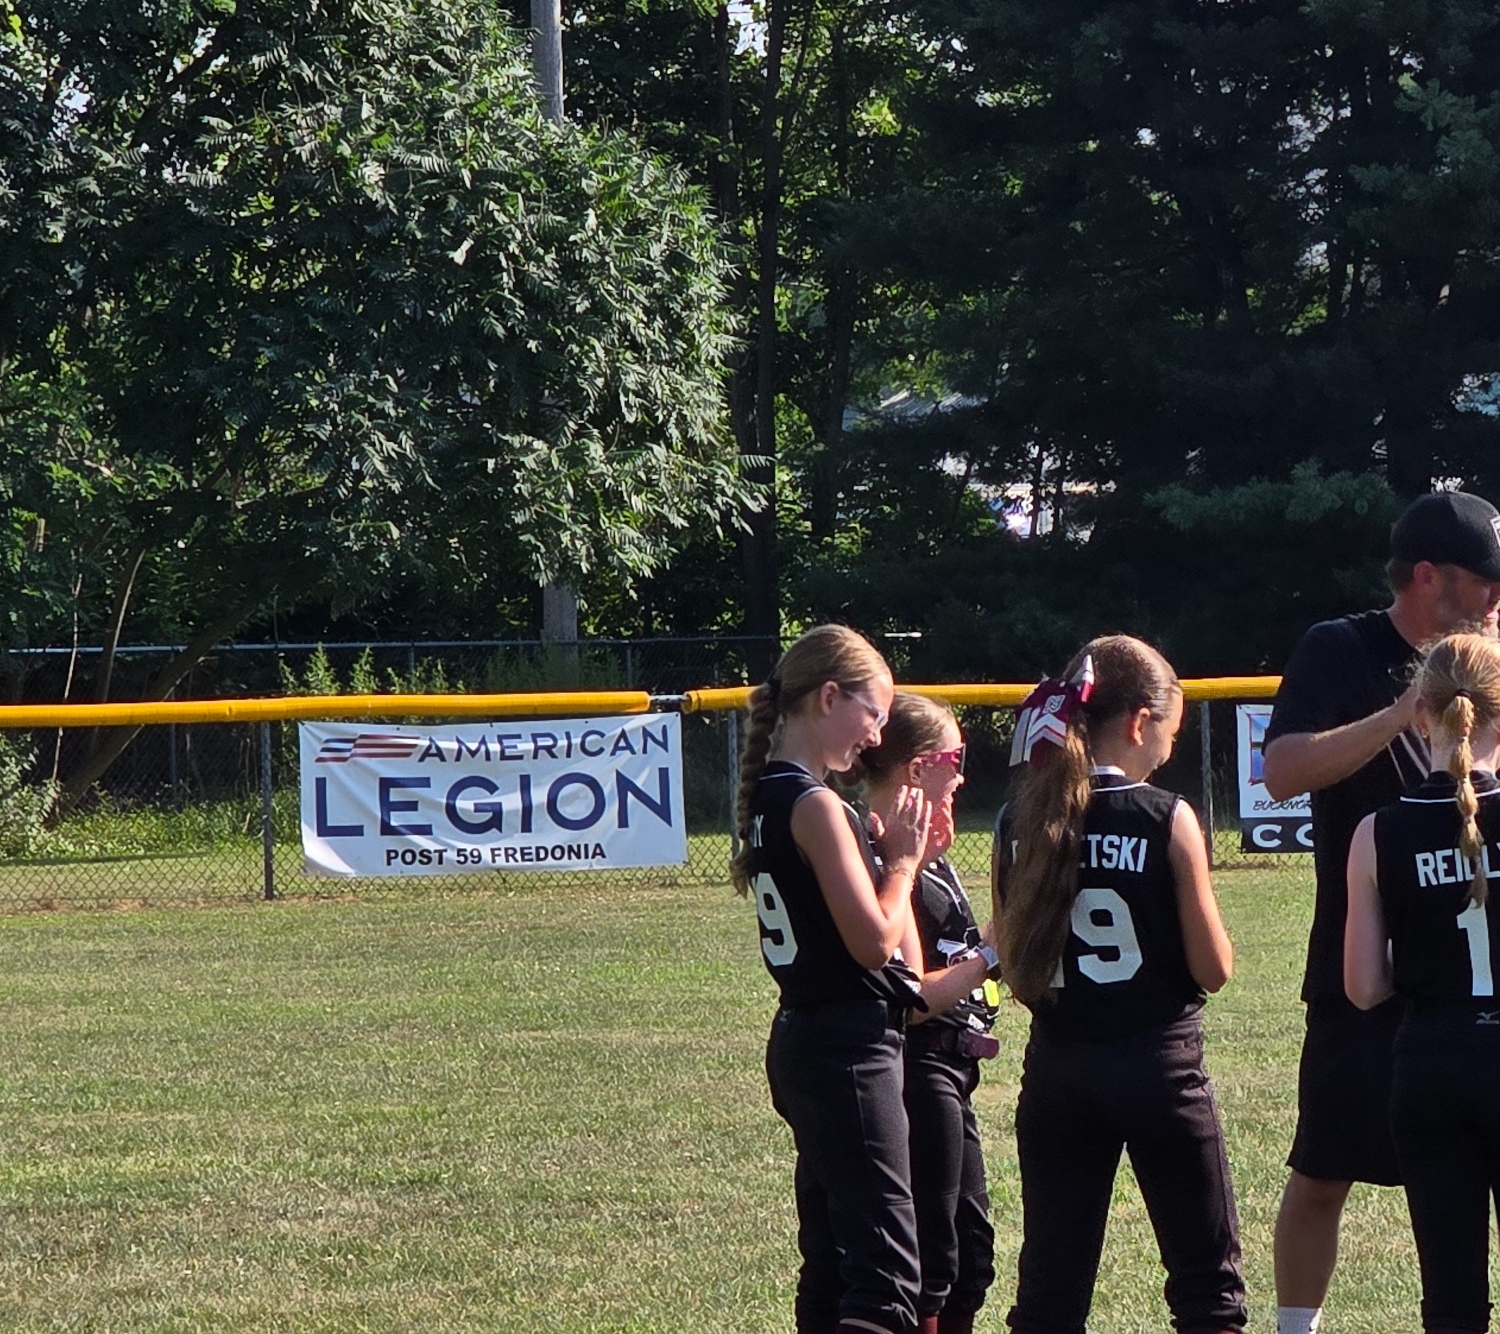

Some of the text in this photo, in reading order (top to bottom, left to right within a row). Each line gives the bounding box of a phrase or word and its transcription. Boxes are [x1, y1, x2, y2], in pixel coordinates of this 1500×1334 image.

[417, 724, 670, 764] AMERICAN
[315, 766, 673, 838] LEGION
[385, 843, 606, 866] POST 59 FREDONIA
[751, 872, 798, 966] 9
[1050, 888, 1143, 988] 9
[1456, 897, 1494, 996] 1
